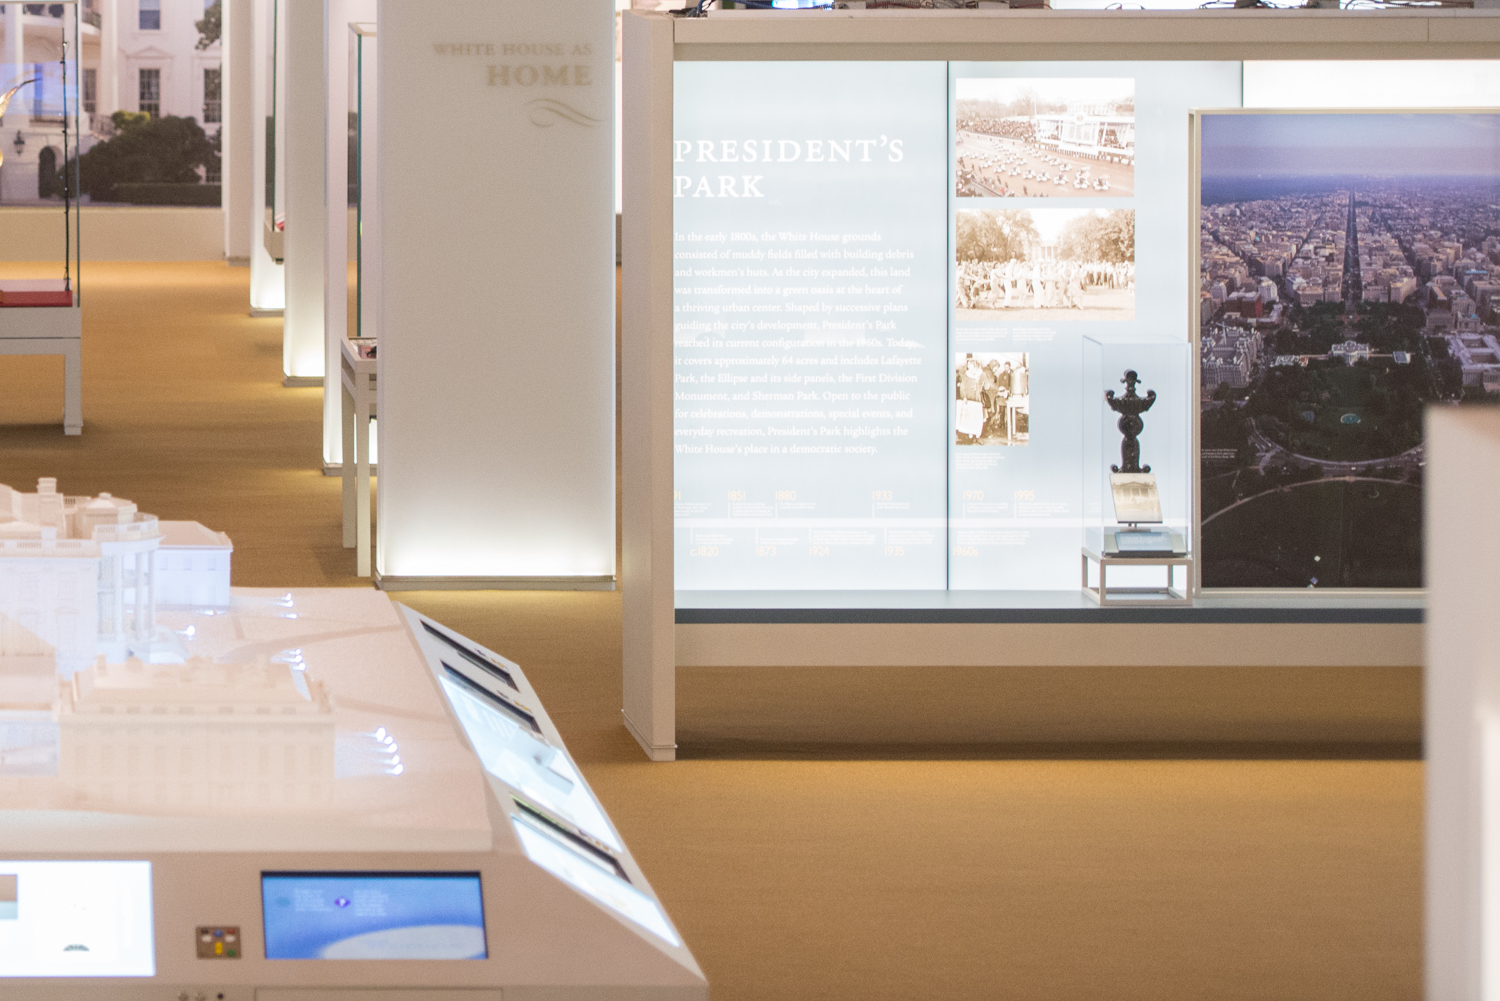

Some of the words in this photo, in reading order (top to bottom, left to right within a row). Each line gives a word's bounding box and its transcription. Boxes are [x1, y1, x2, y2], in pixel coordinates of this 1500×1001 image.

[432, 43, 495, 56] WHITE
[502, 43, 565, 56] HOUSE
[571, 43, 592, 56] AS
[486, 64, 592, 86] HOME
[674, 134, 904, 163] PRESIDENT'S
[674, 175, 764, 198] PARK
[674, 231, 685, 242] In
[687, 231, 703, 242] the
[705, 231, 727, 245] early
[730, 231, 758, 244] 1800s,
[761, 231, 776, 242] the
[778, 231, 807, 242] White
[809, 231, 840, 242] House
[842, 231, 882, 245] grounds
[674, 249, 718, 260] consisted
[719, 249, 732, 260] of
[732, 249, 765, 263] muddy
[768, 249, 792, 260] fields
[794, 249, 818, 260] filled
[820, 249, 840, 260] with
[843, 249, 884, 263] building
[885, 249, 914, 260] debris
[674, 266, 692, 277] and
[694, 266, 744, 277] workmen's
[746, 266, 770, 277] huts.
[771, 266, 783, 277] As
[785, 266, 800, 277] the
[802, 266, 819, 280] city
[821, 266, 868, 280] expanded,
[870, 266, 888, 277] this
[890, 266, 911, 277] land
[674, 287, 692, 295] was
[694, 284, 751, 295] transformed
[754, 284, 773, 295] into
[782, 287, 808, 298] green
[811, 284, 834, 295] oasis
[835, 285, 846, 295] at
[847, 284, 863, 295] the
[865, 284, 889, 295] heart
[891, 284, 904, 295] of
[682, 302, 720, 316] thriving
[722, 302, 750, 313] urban
[752, 303, 782, 313] center.
[785, 302, 819, 316] Shaped
[821, 302, 833, 316] by
[835, 302, 881, 313] successive
[883, 302, 909, 316] plans
[674, 319, 711, 333] guiding
[713, 319, 729, 330] the
[731, 319, 755, 333] city's
[756, 319, 819, 333] development,
[822, 319, 873, 330] President's
[875, 319, 897, 330] Park
[674, 337, 710, 348] reached
[712, 337, 723, 348] its
[725, 338, 759, 348] current
[761, 337, 825, 351] configuration
[826, 337, 836, 348] in
[838, 337, 854, 348] the
[856, 337, 884, 348] 1960s.
[887, 337, 916, 351] Today,
[674, 355, 682, 365] it
[683, 357, 712, 365] covers
[714, 355, 780, 368] approximately
[781, 355, 793, 365] 64
[796, 357, 818, 365] acres
[820, 355, 838, 365] and
[840, 355, 879, 365] includes
[881, 355, 922, 368] Lafayette
[674, 372, 698, 385] Park,
[700, 372, 715, 383] the
[717, 372, 748, 386] Ellipse
[750, 372, 768, 383] and
[770, 372, 782, 383] its
[784, 372, 802, 383] side
[803, 372, 836, 386] panels,
[838, 372, 853, 383] the
[855, 372, 877, 383] First
[878, 372, 918, 383] Division
[674, 390, 730, 403] Monument,
[732, 390, 750, 401] and
[752, 390, 794, 401] Sherman
[797, 390, 820, 401] Park.
[822, 390, 849, 404] Open
[851, 391, 861, 401] to
[863, 390, 878, 401] the
[880, 390, 910, 404] public
[674, 408, 688, 418] for
[690, 408, 749, 420] celebrations,
[751, 408, 826, 420] demonstrations,
[828, 408, 860, 421] special
[861, 409, 893, 420] events,
[895, 408, 913, 418] and
[674, 425, 714, 439] everyday
[716, 425, 765, 438] recreation,
[767, 425, 818, 436] President's
[820, 425, 841, 436] Park
[843, 425, 891, 439] highlights
[893, 425, 908, 436] the
[674, 443, 703, 454] White
[705, 443, 742, 454] House's
[744, 443, 768, 457] place
[770, 443, 780, 454] in
[789, 443, 842, 454] democratic
[844, 443, 878, 457] society.
[727, 490, 746, 501] 1851
[775, 490, 797, 501] 1880
[872, 490, 892, 501] 1933
[963, 490, 984, 501] 1970
[1014, 490, 1035, 501] 1995
[690, 546, 719, 557] c.1820
[756, 546, 777, 557] 1873
[809, 546, 830, 557] 1924
[884, 546, 904, 557] 1935
[953, 546, 978, 557] 1960s
